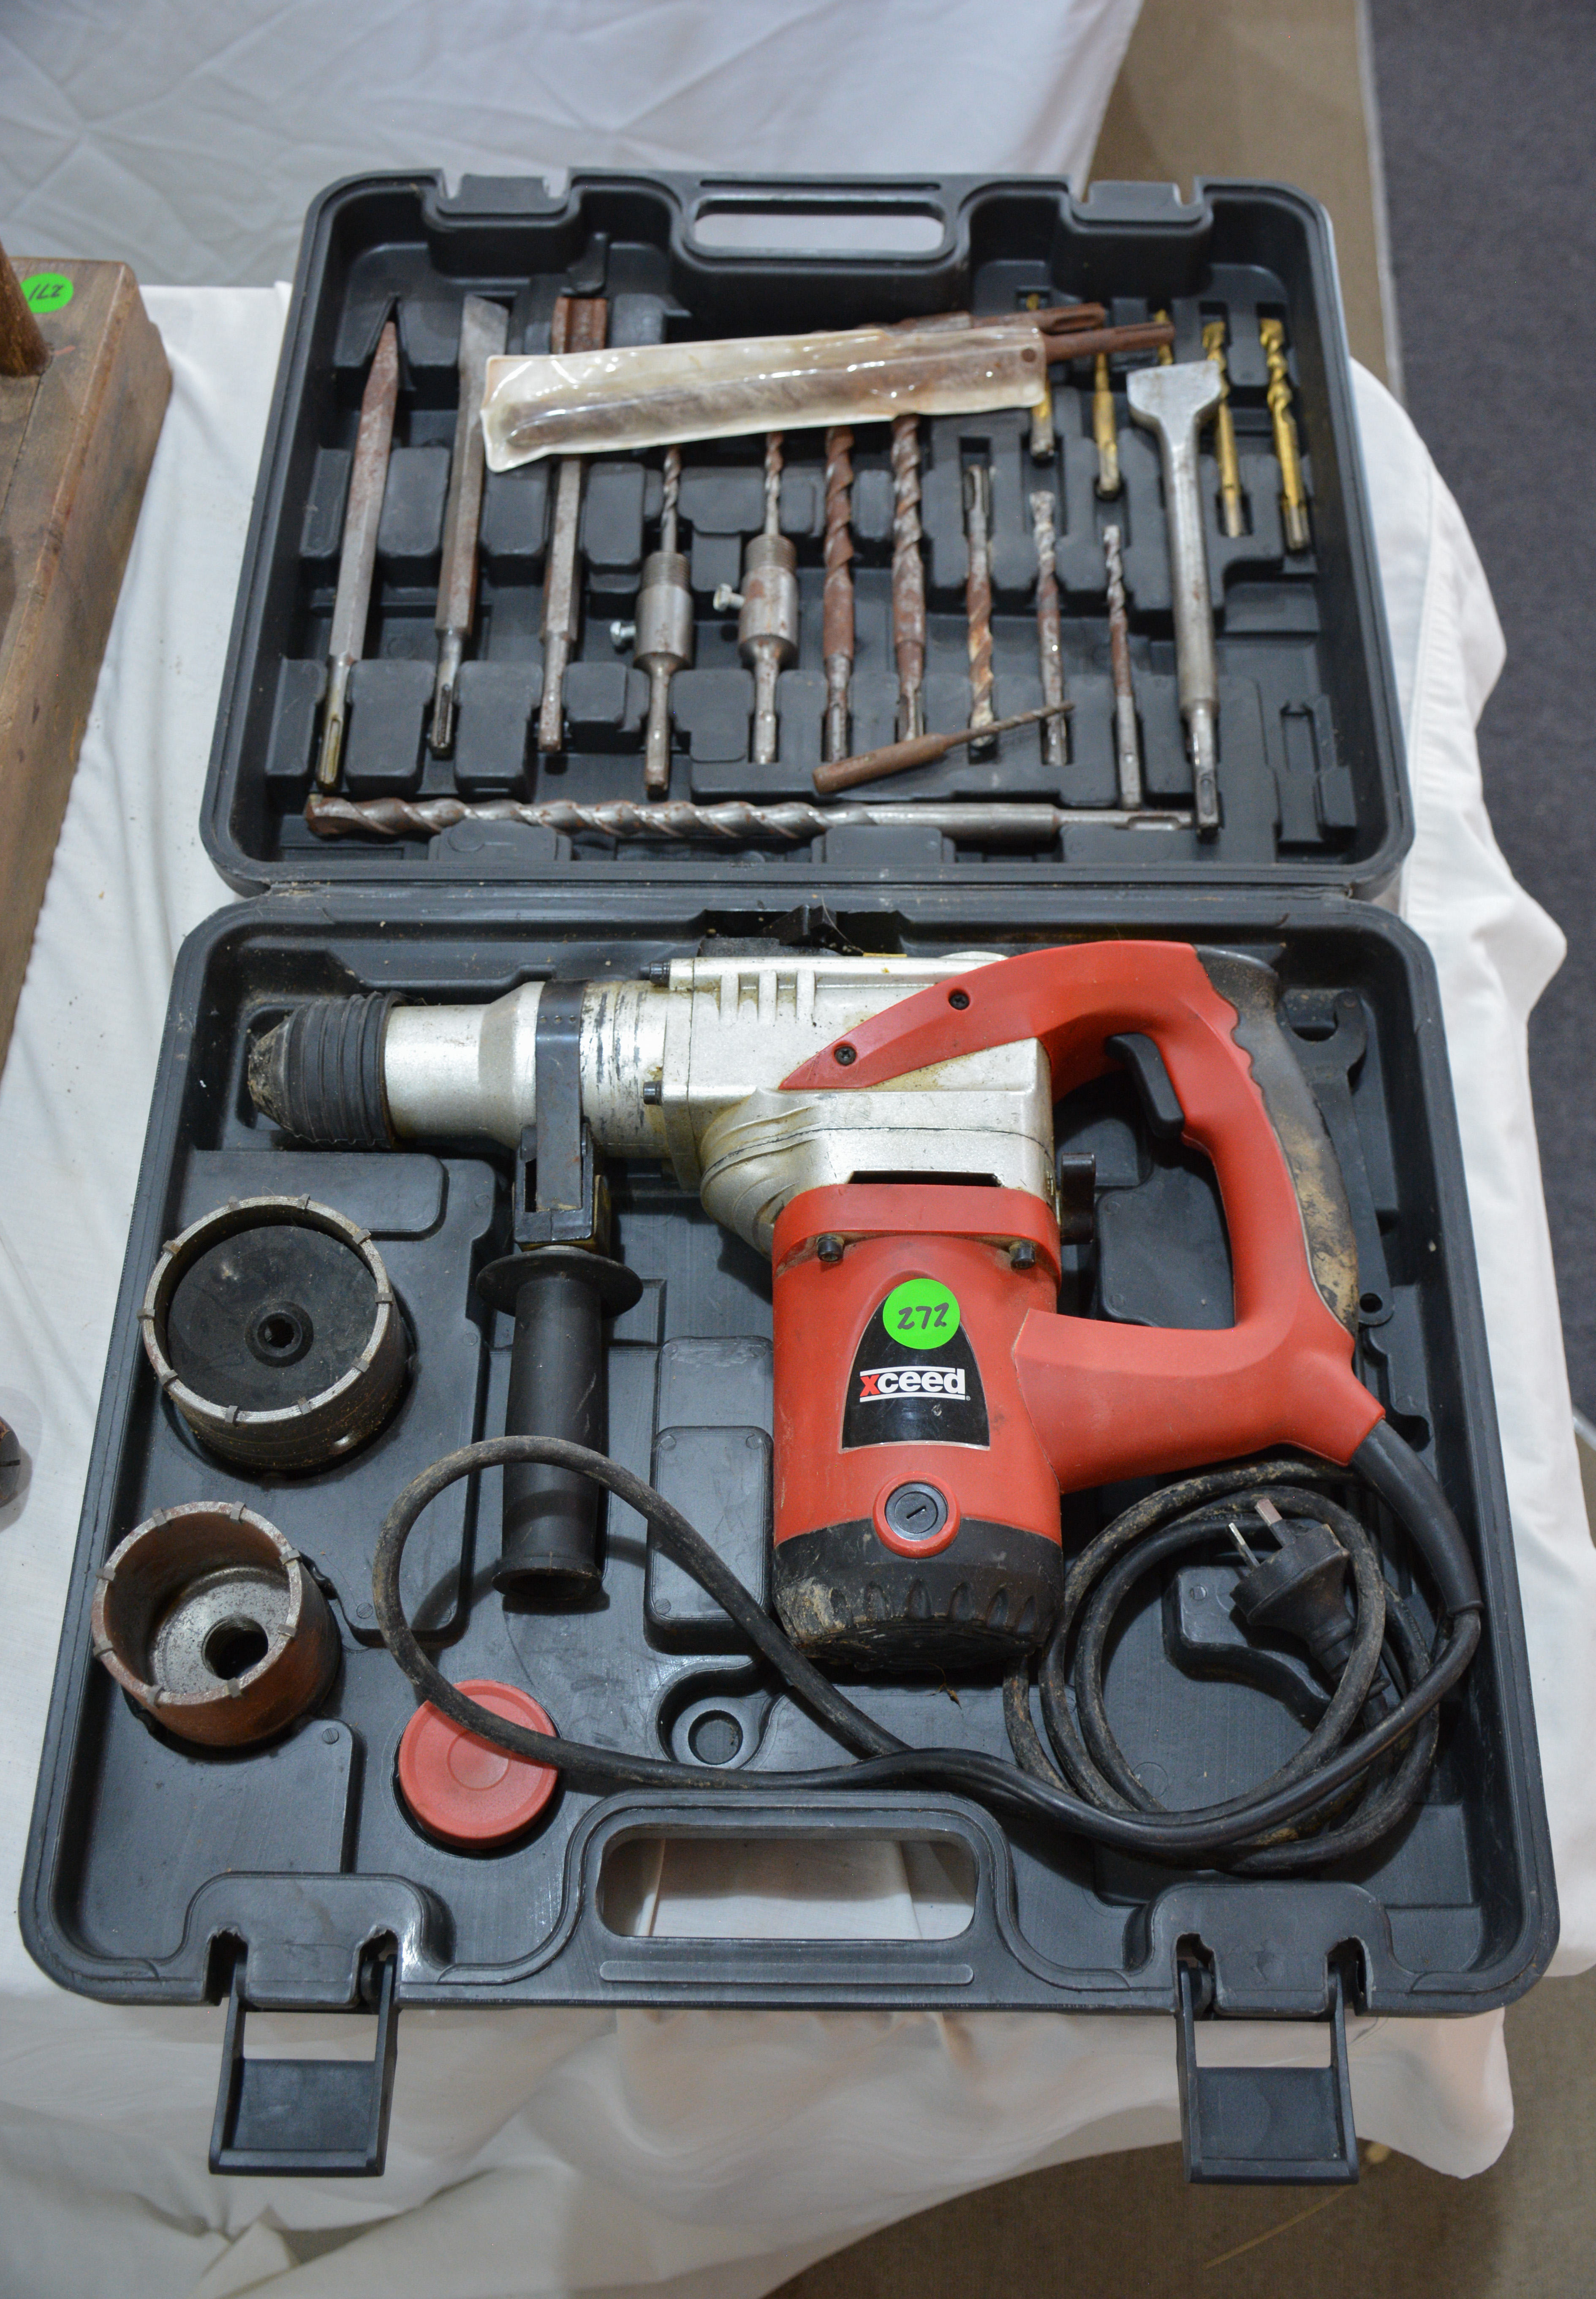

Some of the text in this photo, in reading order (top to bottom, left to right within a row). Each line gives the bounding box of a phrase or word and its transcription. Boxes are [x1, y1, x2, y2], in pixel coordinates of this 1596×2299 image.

[28, 283, 64, 302] 271
[897, 1302, 949, 1330] 272
[860, 1369, 965, 1397] xceed
